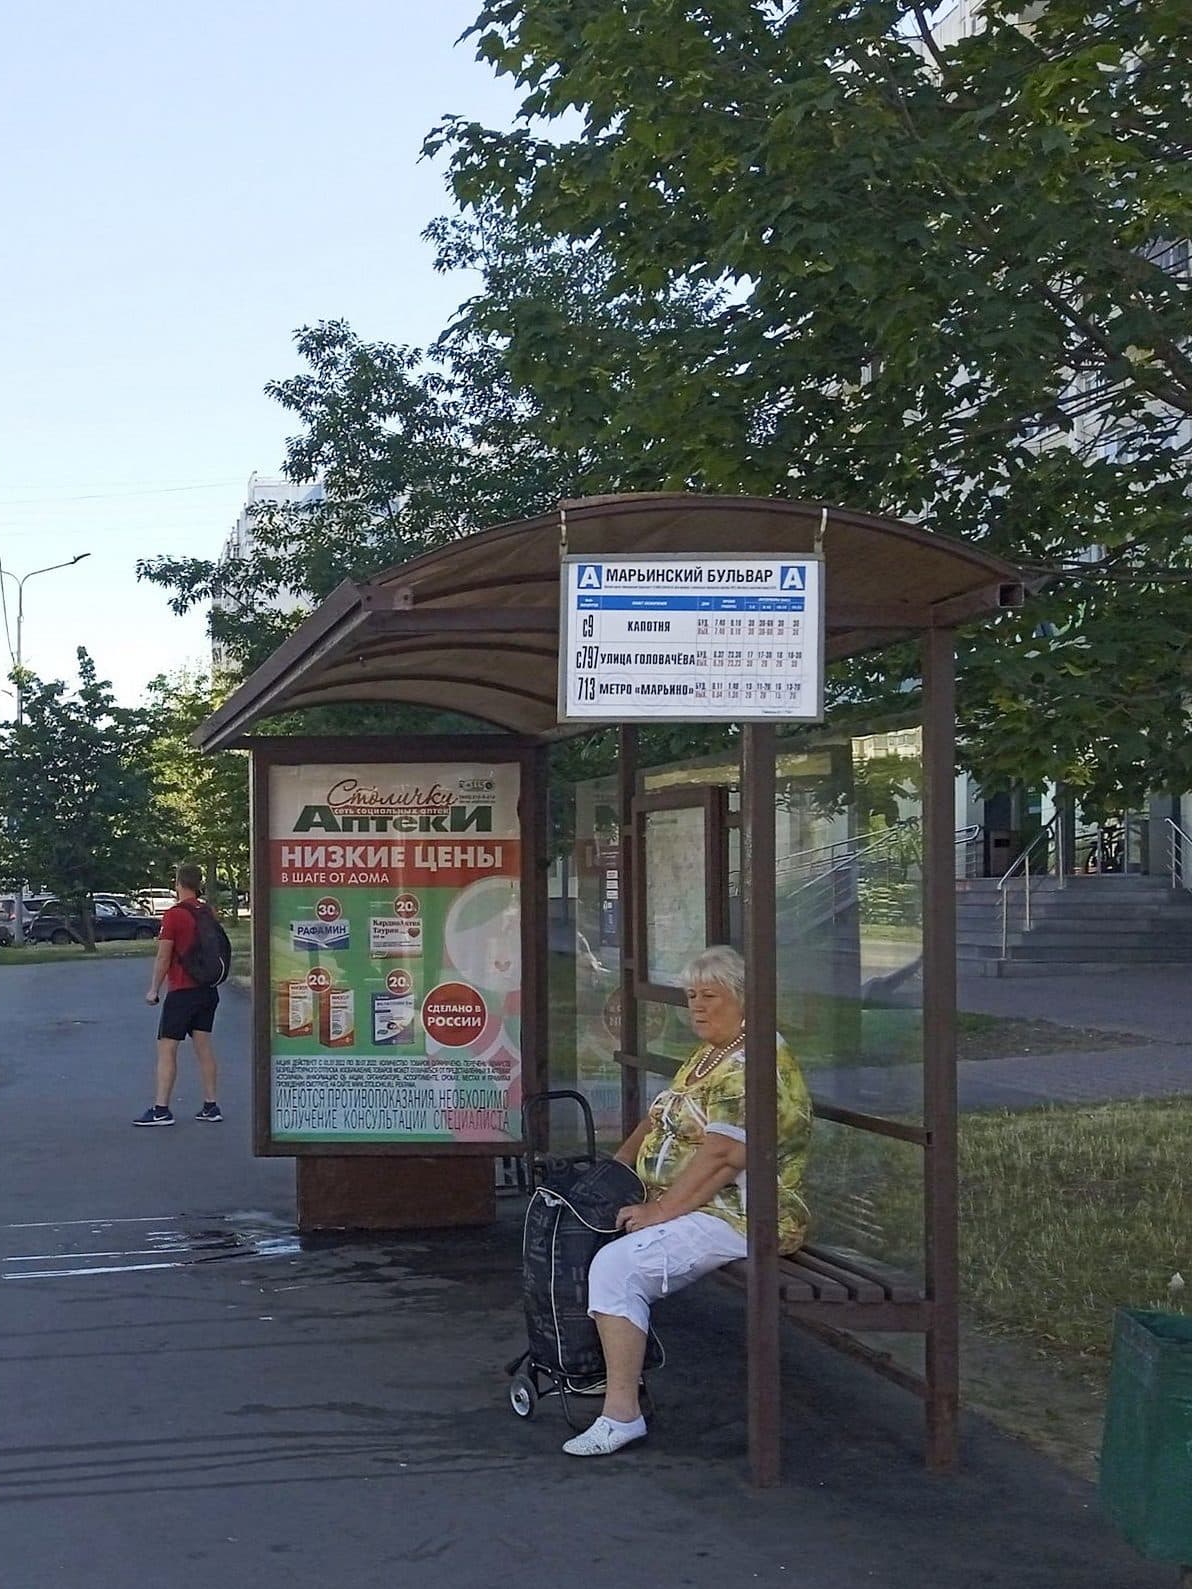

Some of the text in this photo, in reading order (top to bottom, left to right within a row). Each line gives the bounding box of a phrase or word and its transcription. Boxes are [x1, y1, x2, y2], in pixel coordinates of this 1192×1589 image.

[606, 566, 703, 582] МАРЬИНСКИЙ
[708, 569, 773, 583] БУЛЬВАР
[627, 621, 671, 632] КАПОТНЯ
[600, 653, 632, 665] УЛИЦА
[634, 652, 696, 665] ГОЛОВАЧЁВА
[578, 677, 694, 700] 713 МЕТРО «МАРЬИНО»
[326, 778, 458, 807] Столички
[281, 845, 503, 871] НИЗКИЕ ЦЕНЫ
[282, 872, 390, 884] В ШАГЕ ОТ ДОМА
[297, 925, 346, 936] РАФАМИН
[427, 1005, 473, 1014] СДЕЛАНО
[427, 1016, 482, 1027] РОССИИ
[276, 1088, 326, 1109] ИМЕЮТСЯ
[439, 1088, 509, 1109] НЕОБХОДИМО
[276, 1109, 510, 1131] ПОЛУЧЕНИЕ КОНСУЛЬТАЦИИ СПЕЦИАЛИСТА
